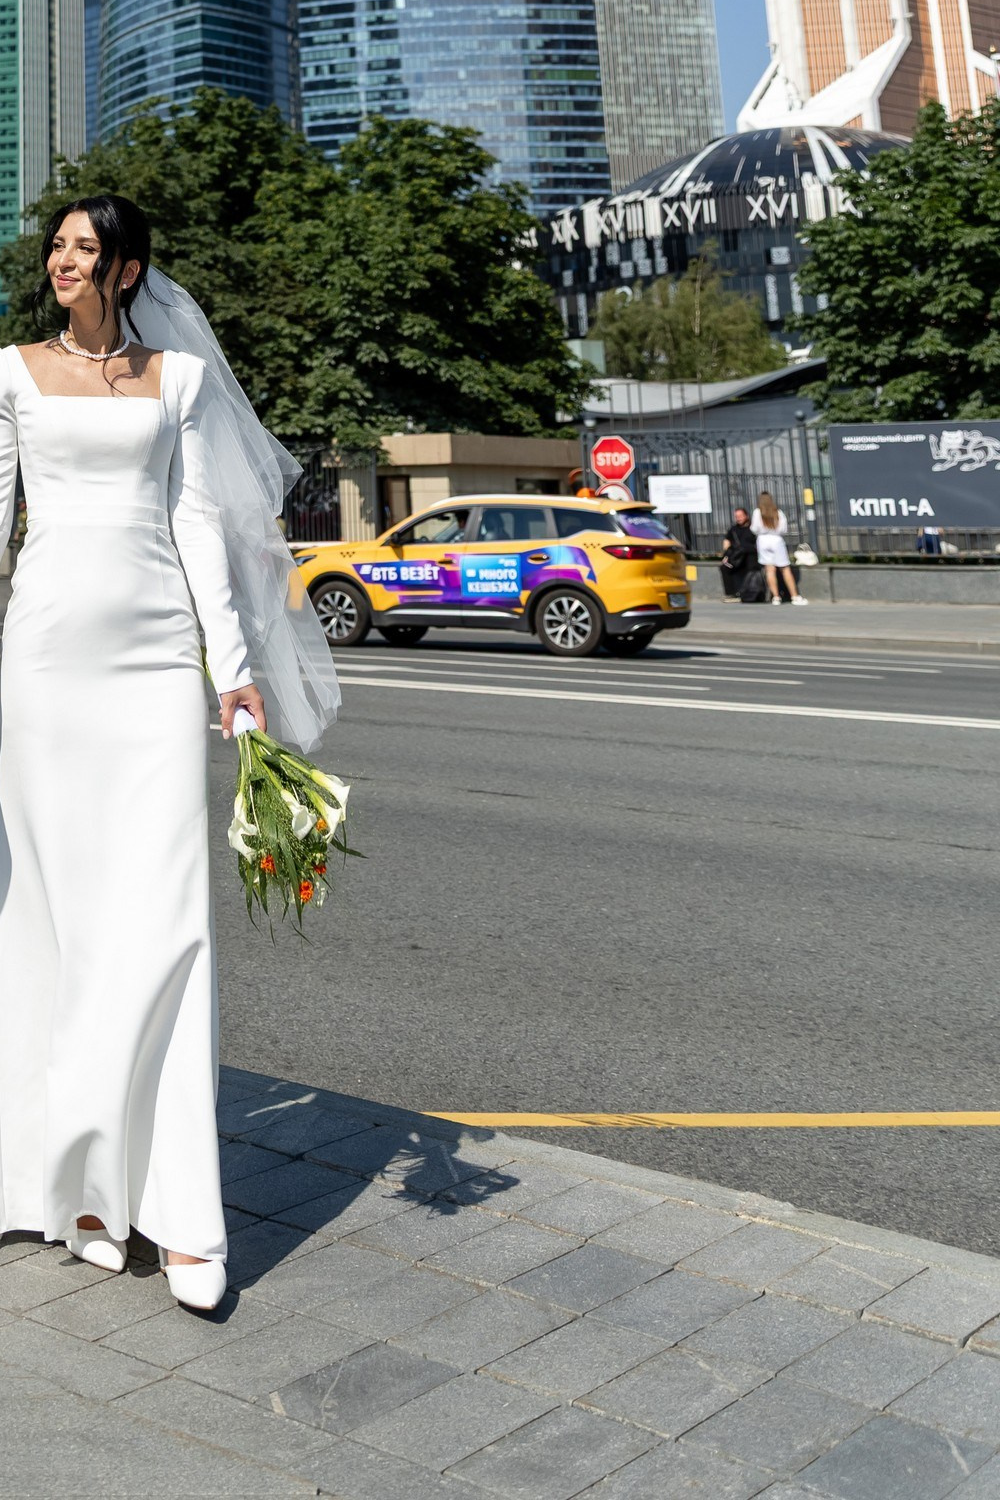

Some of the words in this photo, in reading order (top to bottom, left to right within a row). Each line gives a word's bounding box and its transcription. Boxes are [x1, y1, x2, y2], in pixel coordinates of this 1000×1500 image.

[662, 198, 717, 228] XVII
[746, 192, 798, 221] XVI
[596, 452, 630, 467] STOP
[850, 498, 897, 517] КПП
[371, 566, 397, 581] ВТБ
[400, 563, 440, 581] ВЕЗЁТ
[478, 568, 517, 579] МНОГО
[467, 581, 518, 593] КЕШБЭКА
